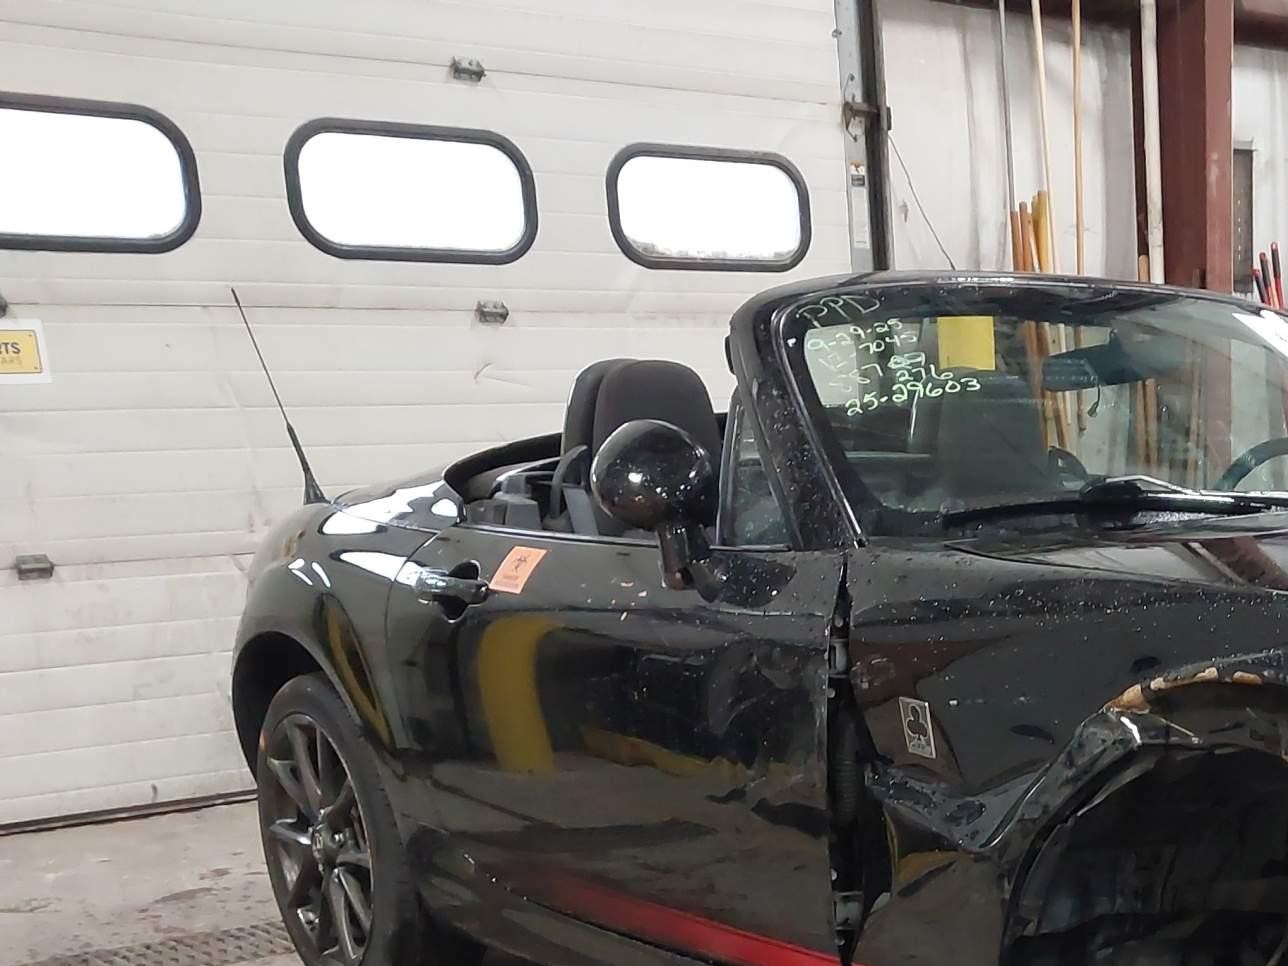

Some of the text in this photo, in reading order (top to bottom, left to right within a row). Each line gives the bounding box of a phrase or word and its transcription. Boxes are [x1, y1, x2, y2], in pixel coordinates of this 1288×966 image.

[796, 295, 881, 329] PPD
[0, 342, 21, 355] TS
[845, 377, 982, 416] 25-29603
